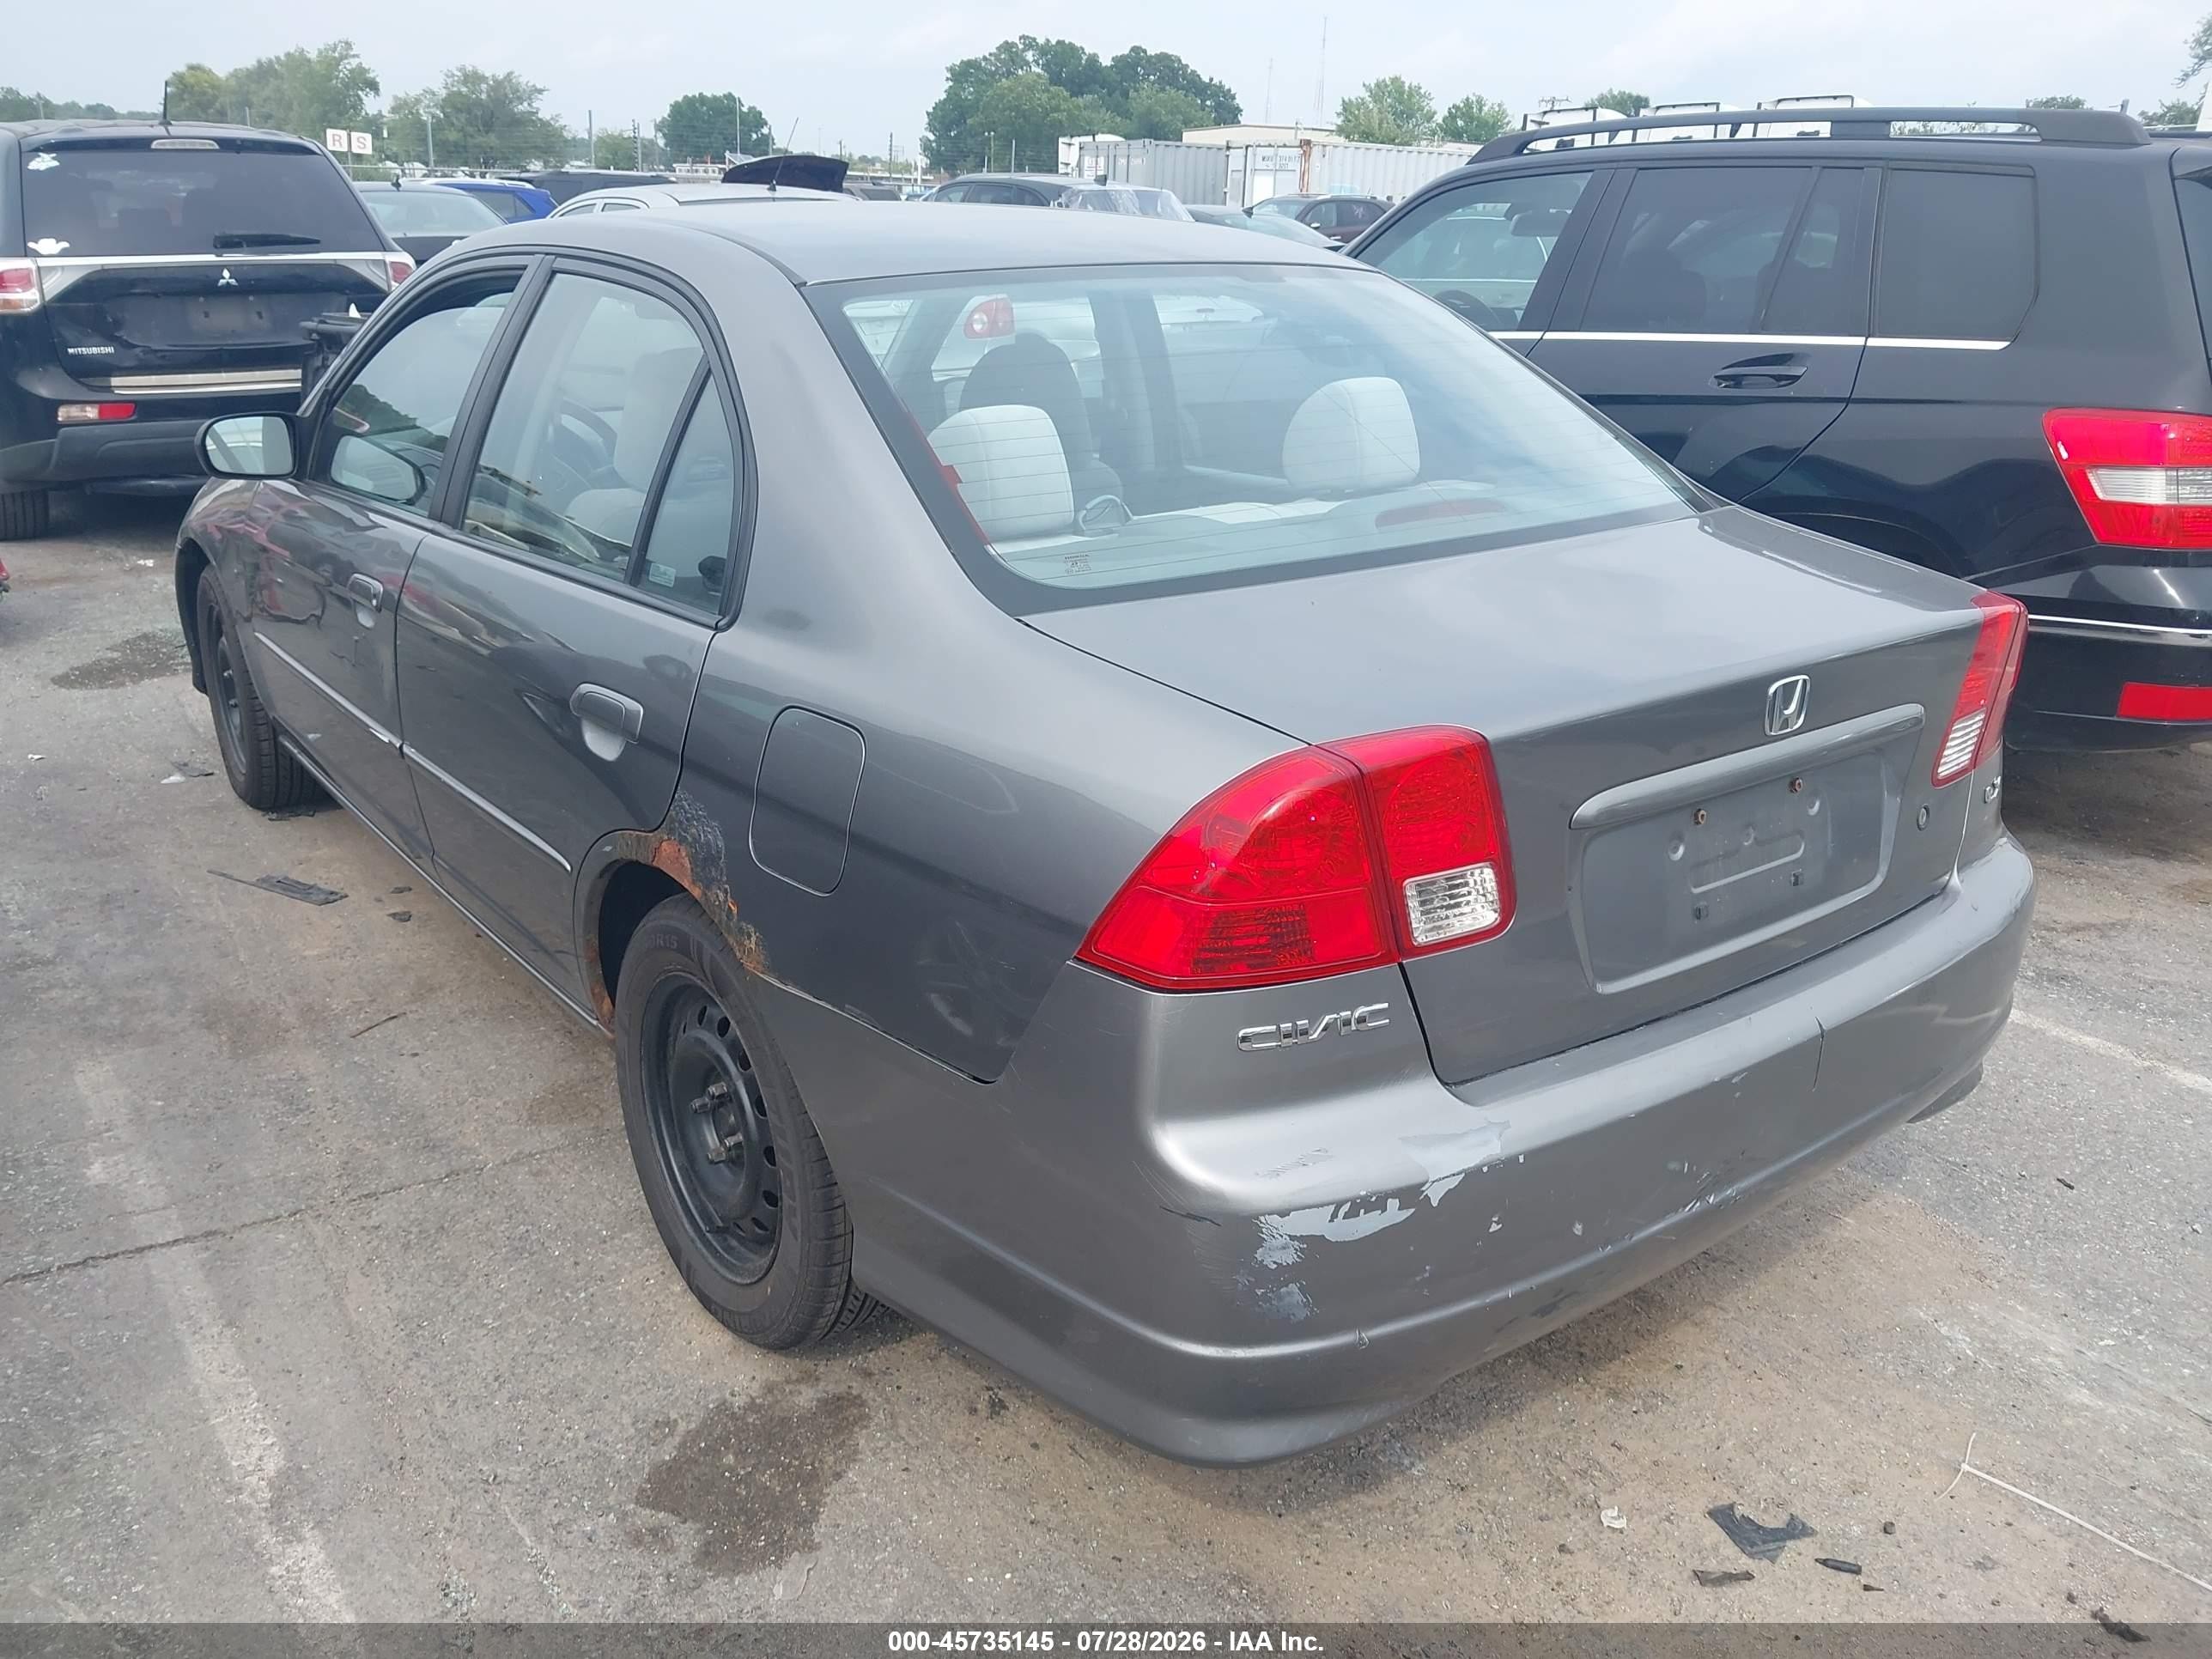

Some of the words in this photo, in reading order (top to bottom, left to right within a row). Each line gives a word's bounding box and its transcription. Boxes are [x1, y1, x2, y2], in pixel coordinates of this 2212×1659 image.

[332, 133, 343, 147] R
[356, 136, 368, 149] S
[67, 346, 115, 356] MITSUBISHI
[1237, 1002, 1390, 1051] CIVIC
